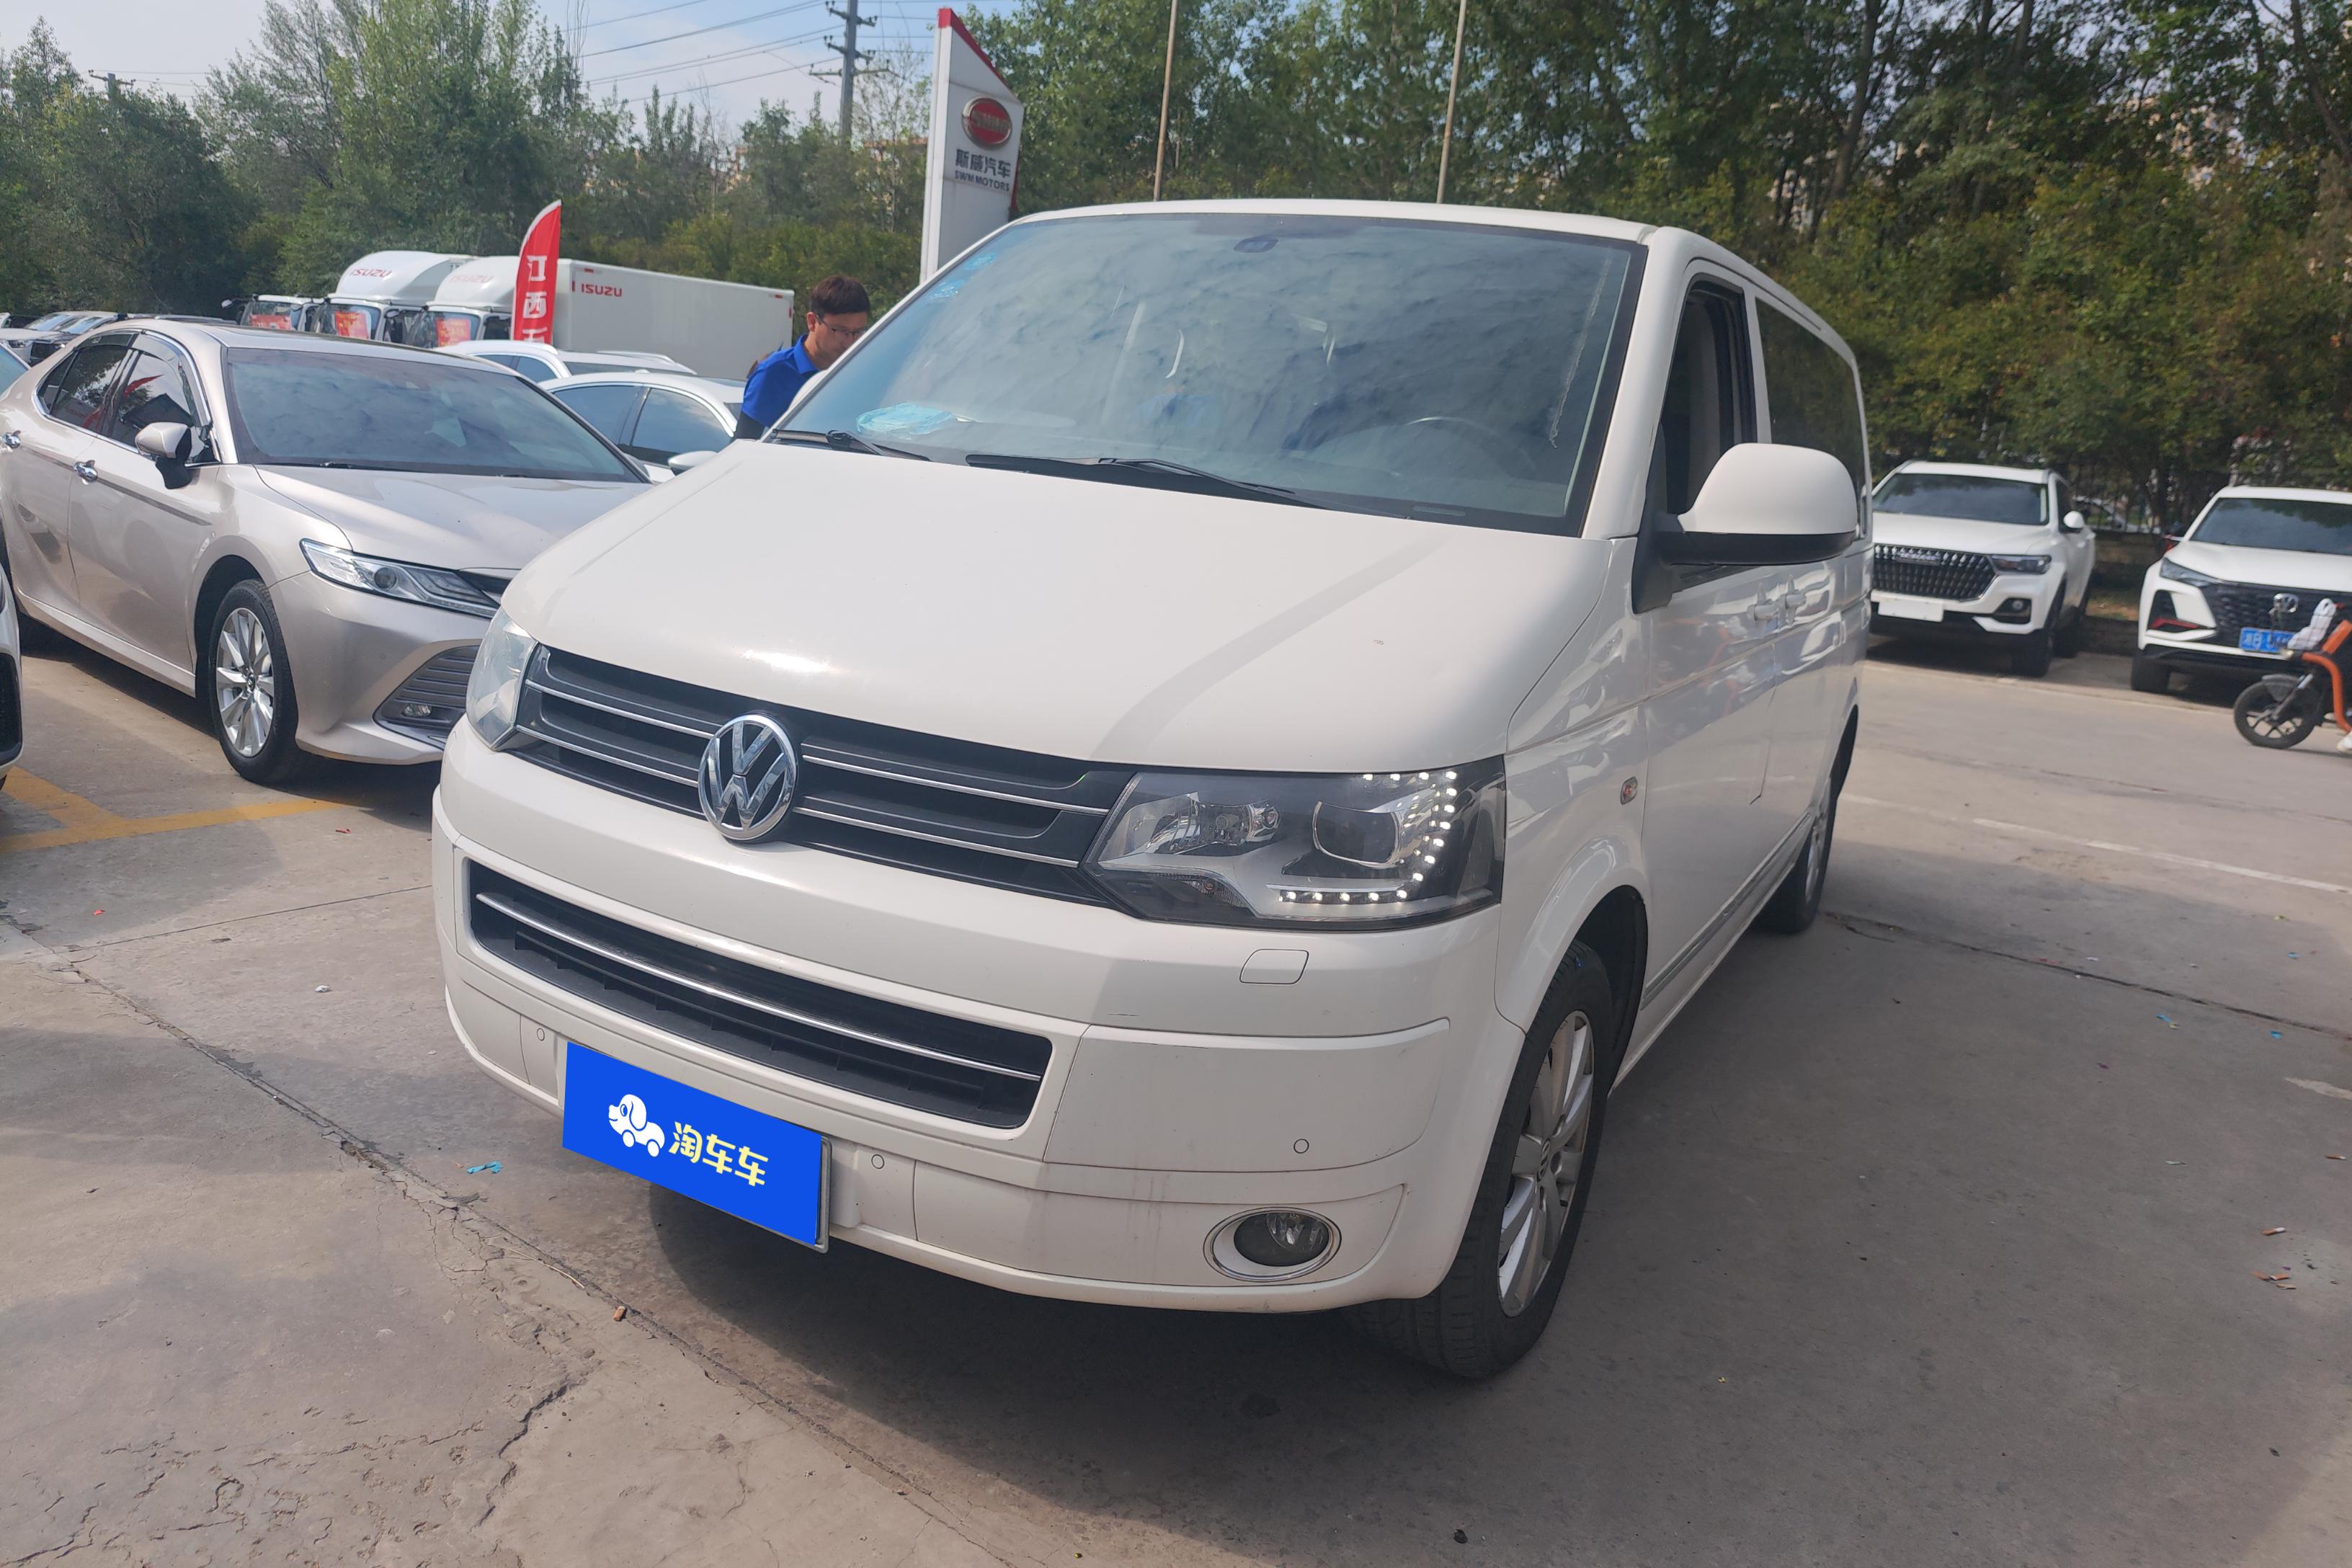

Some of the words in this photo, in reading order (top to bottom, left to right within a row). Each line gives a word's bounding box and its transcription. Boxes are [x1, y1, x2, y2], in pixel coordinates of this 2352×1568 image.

[955, 148, 1011, 179] 斯威汽车
[955, 170, 974, 183] SWM
[976, 175, 1010, 192] MOTORS
[350, 268, 393, 278] ISUZU
[448, 275, 494, 284] ISUZU
[582, 283, 623, 297] ISUZU
